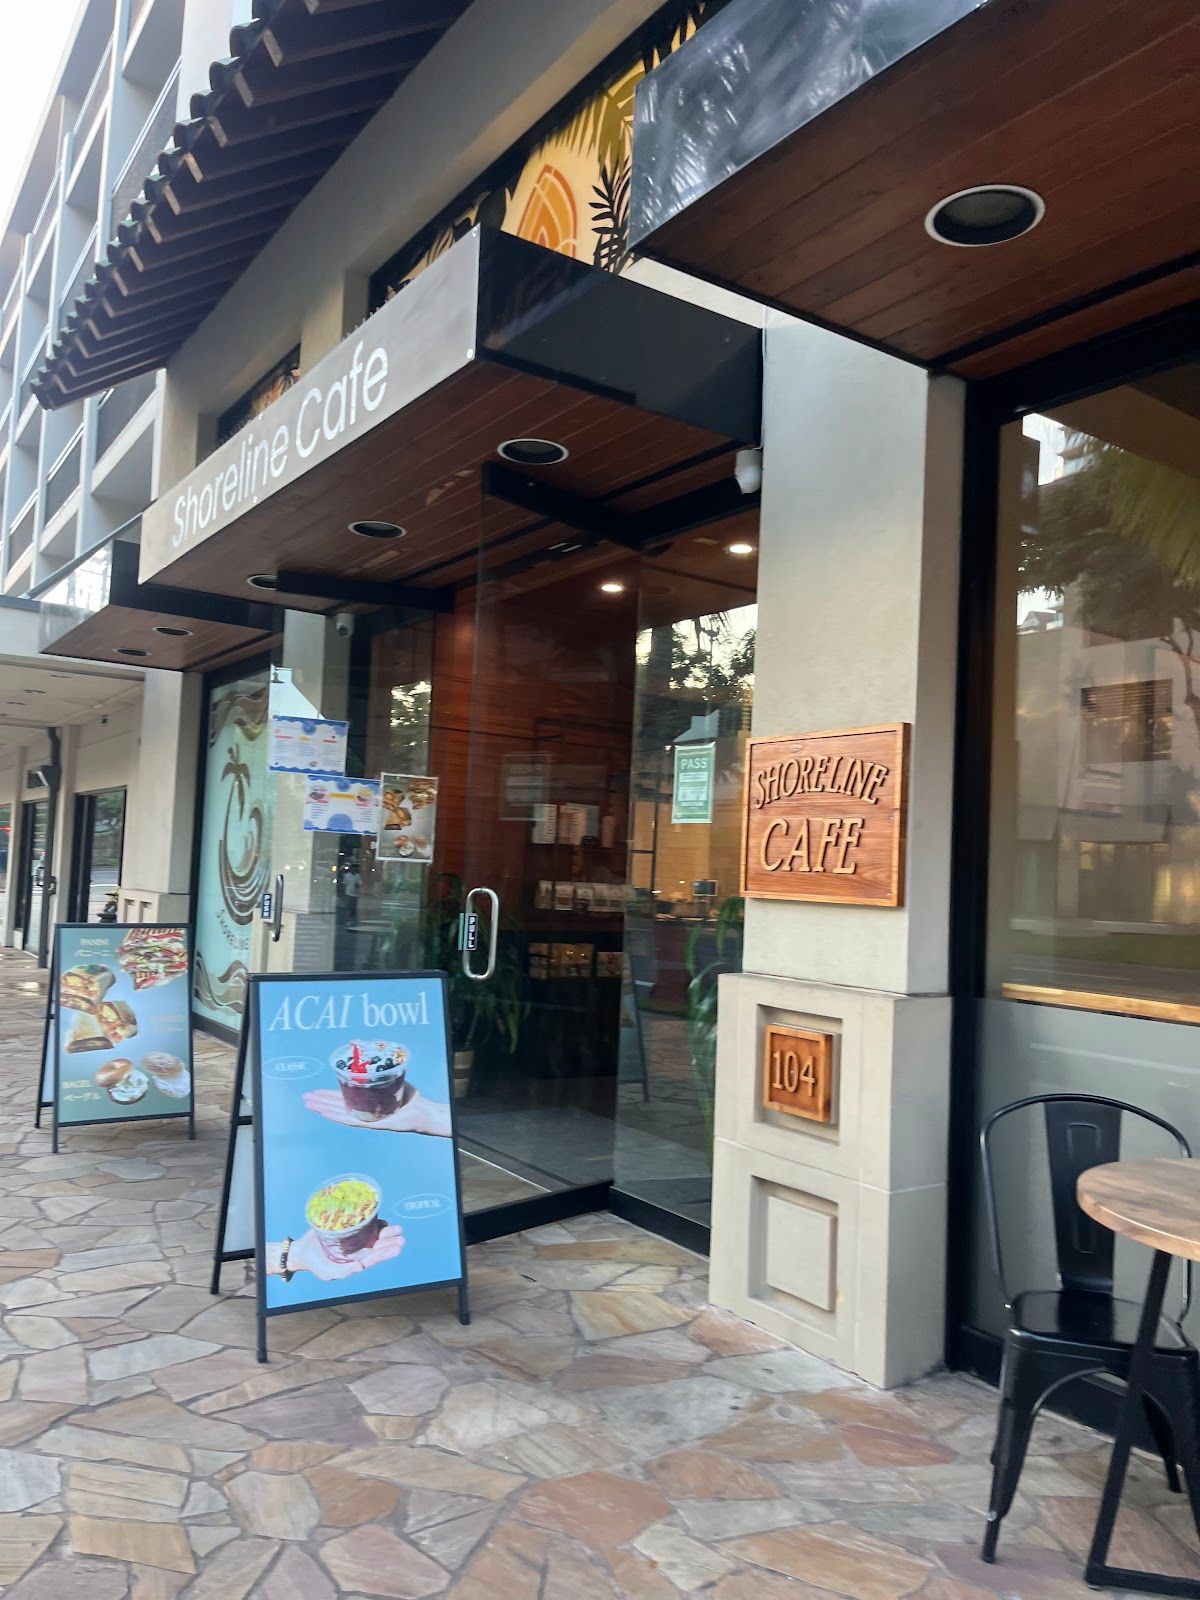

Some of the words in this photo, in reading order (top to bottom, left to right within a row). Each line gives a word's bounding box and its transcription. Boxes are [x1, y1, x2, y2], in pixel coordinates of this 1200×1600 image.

[172, 424, 290, 548] Shoreline
[295, 340, 389, 458] Cafe
[680, 757, 708, 770] PASS
[755, 755, 889, 809] SHORELINE
[760, 817, 865, 875] CAFE
[468, 916, 476, 948] PULL
[268, 994, 352, 1031] ACAI
[361, 992, 430, 1028] bowl
[772, 1050, 817, 1098] 104
